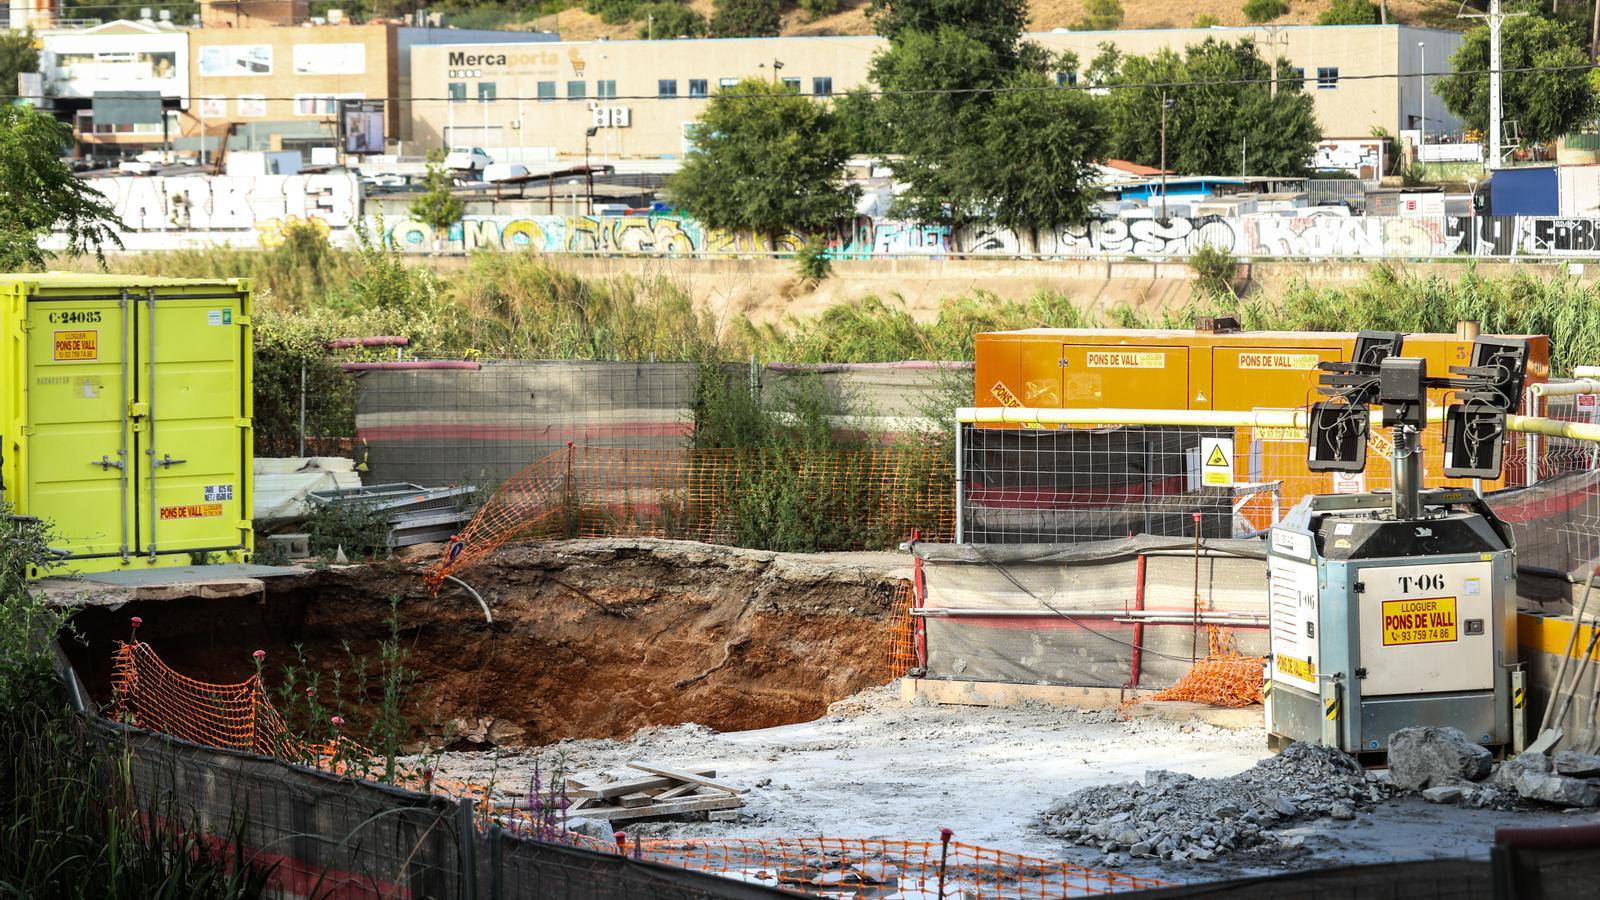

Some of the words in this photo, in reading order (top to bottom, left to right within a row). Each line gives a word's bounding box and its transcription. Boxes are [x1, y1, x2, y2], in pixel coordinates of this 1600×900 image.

[449, 52, 559, 67] Mercaporta
[56, 341, 72, 351] PONS
[73, 340, 81, 350] DE
[82, 339, 96, 350] VALL
[1088, 354, 1109, 366] PONS
[1109, 354, 1120, 366] DE
[1121, 354, 1139, 366] VALL
[1240, 355, 1261, 367] PONS
[1262, 356, 1273, 367] DE
[1273, 356, 1292, 368] VALL
[993, 384, 1013, 405] PONS
[160, 507, 177, 519] PONS
[178, 507, 187, 517] DE
[187, 505, 203, 517] VALL
[1401, 602, 1437, 613] LLOGUER
[1385, 614, 1413, 630] PONS
[1414, 613, 1428, 629] DE
[1429, 611, 1454, 627] VALL
[1401, 631, 1412, 641] 93
[1413, 630, 1427, 640] 759
[1428, 629, 1438, 639] 74
[1439, 628, 1449, 639] 86
[1276, 654, 1288, 672] PONS
[1287, 657, 1294, 674] DE
[1293, 660, 1303, 677] VALL
